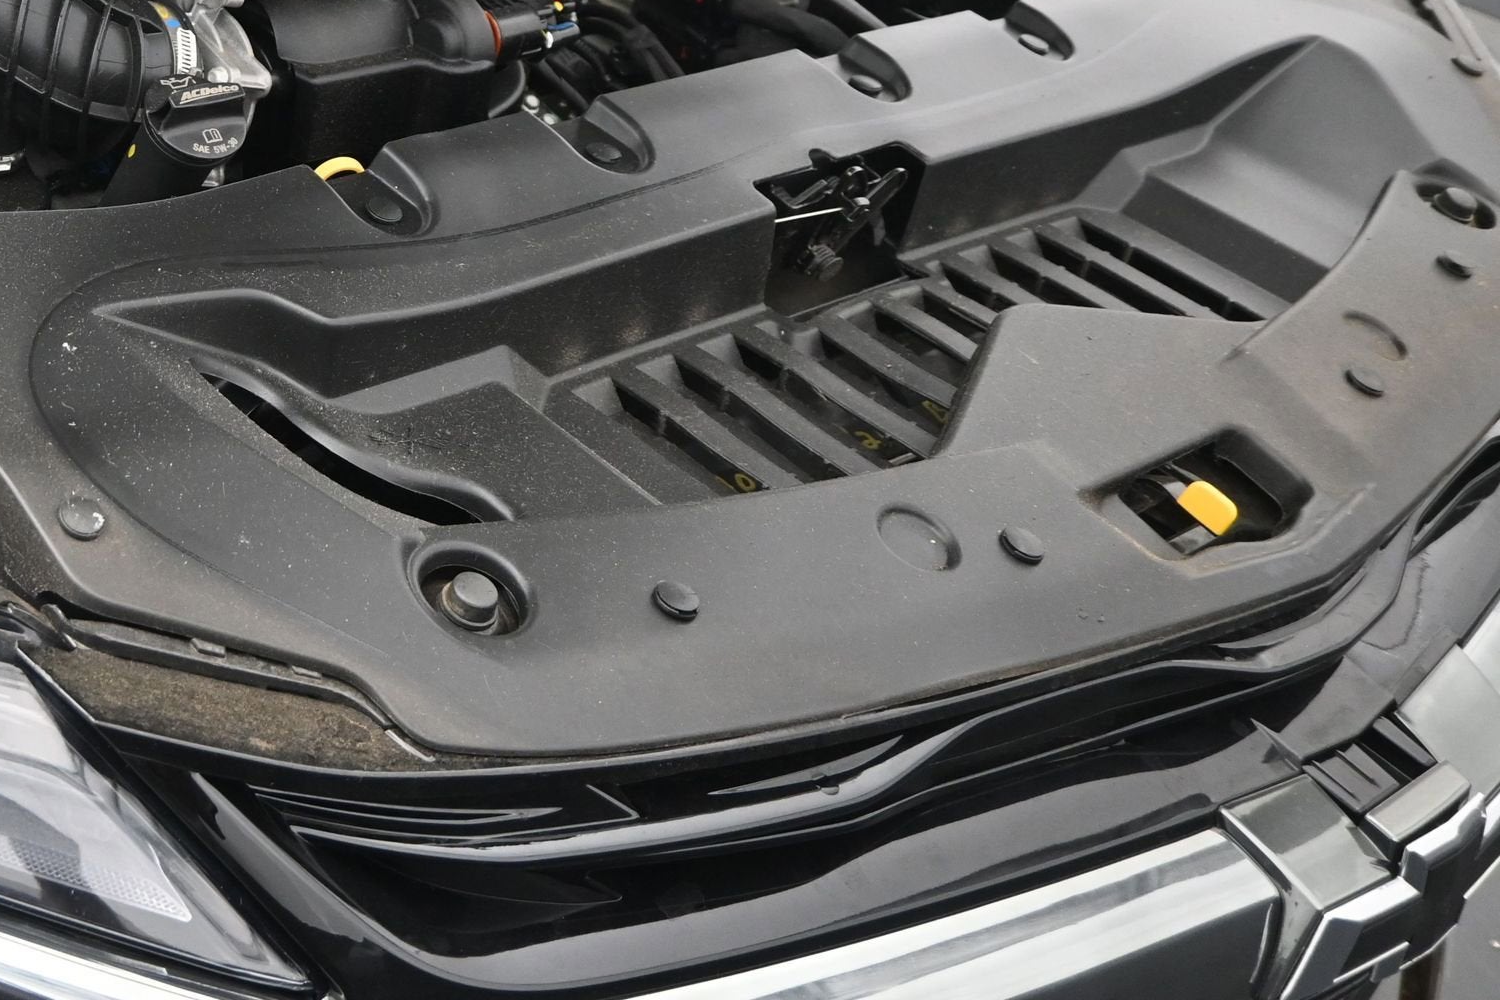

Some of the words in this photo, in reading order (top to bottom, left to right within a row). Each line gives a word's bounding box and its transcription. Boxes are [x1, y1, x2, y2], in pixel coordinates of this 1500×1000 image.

[181, 84, 240, 102] ACDelco
[192, 143, 211, 154] SAE
[213, 137, 239, 154] 5W-30
